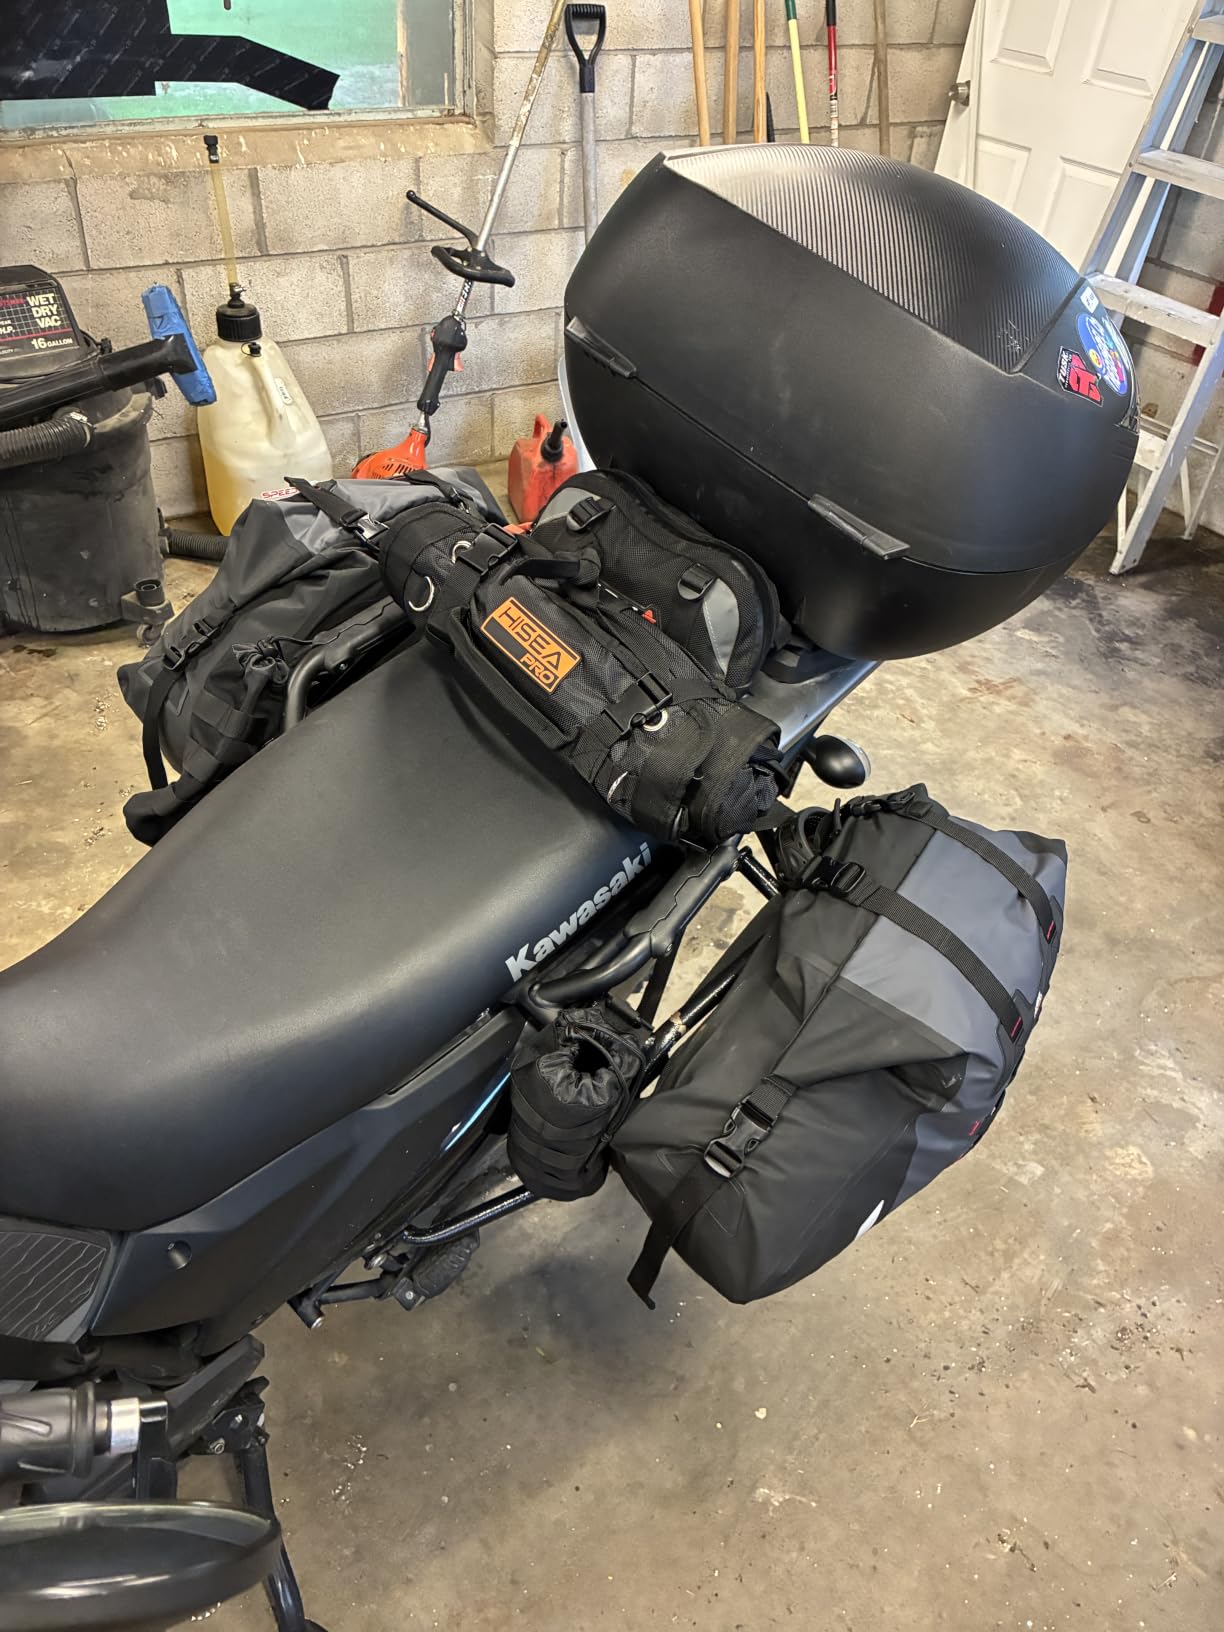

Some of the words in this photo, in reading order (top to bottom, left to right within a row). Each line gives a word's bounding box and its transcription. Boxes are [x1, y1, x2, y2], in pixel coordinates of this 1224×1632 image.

[26, 293, 55, 306] WET
[31, 304, 58, 317] DRY
[36, 315, 61, 328] VAC
[31, 338, 47, 349] 16
[47, 338, 73, 347] GALLON
[1058, 350, 1070, 384] TUSK
[498, 606, 562, 671] HISEA
[520, 652, 555, 685] PRO
[504, 841, 652, 983] Kawasaki
